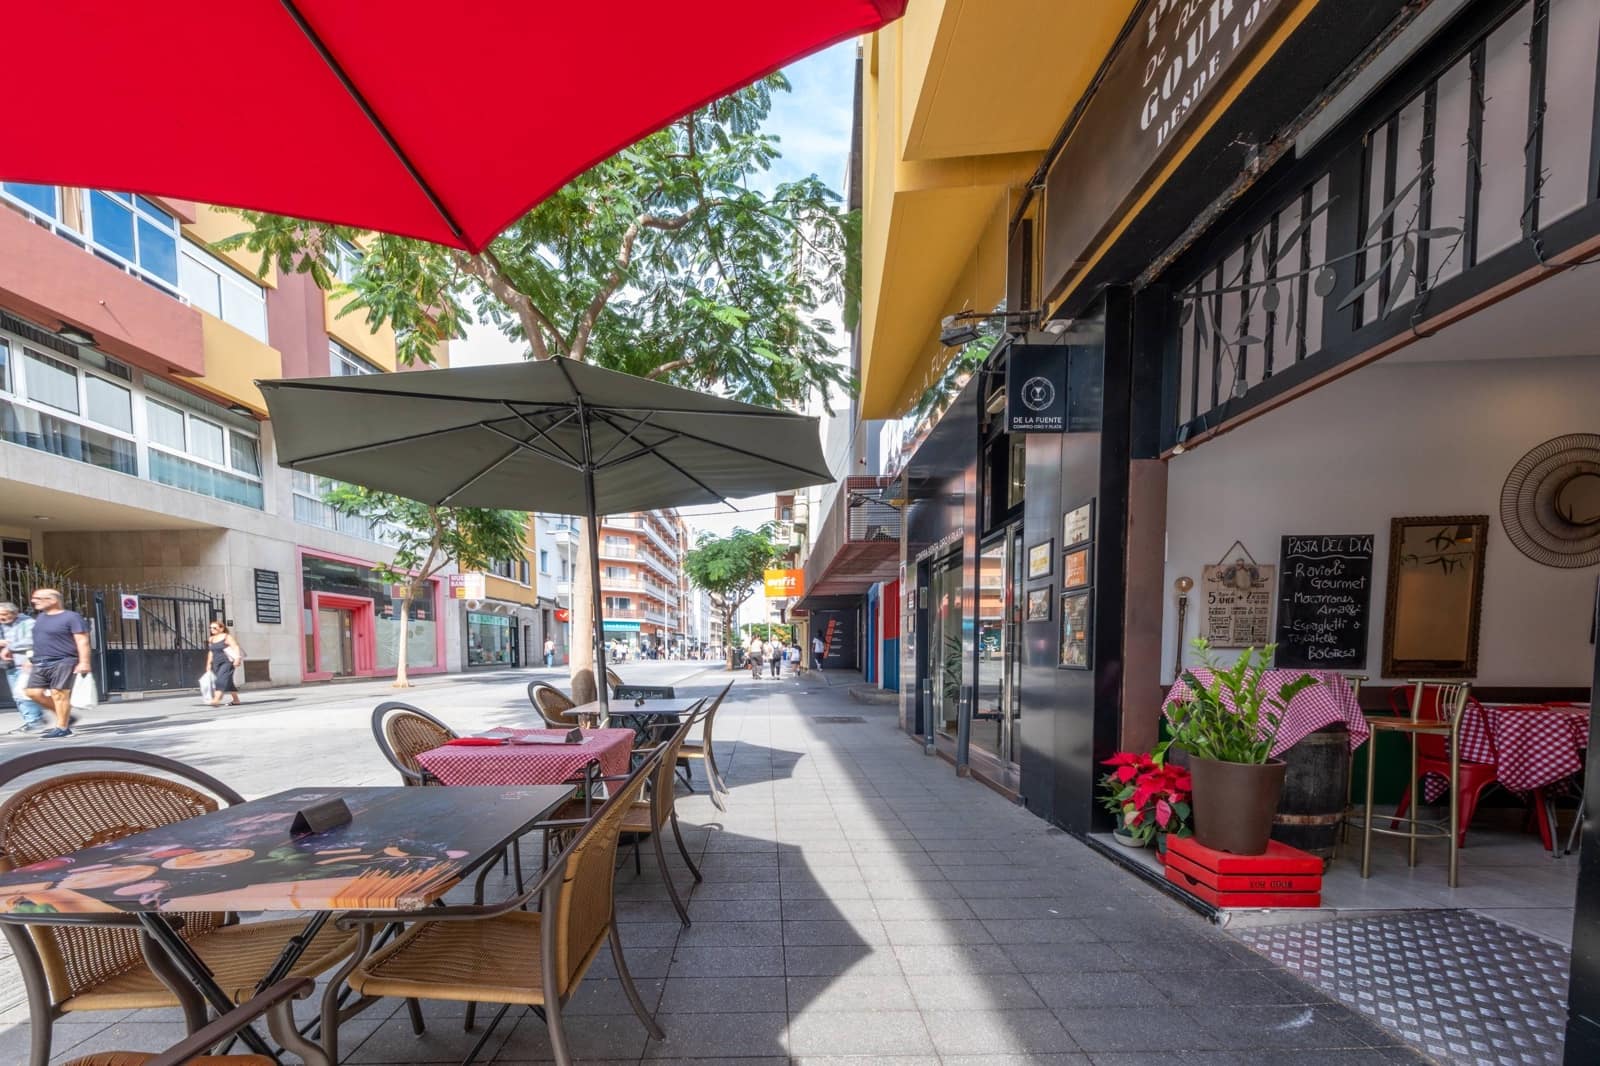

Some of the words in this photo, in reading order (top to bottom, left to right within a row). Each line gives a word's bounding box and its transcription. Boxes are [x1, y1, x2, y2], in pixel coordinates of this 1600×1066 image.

[1157, 50, 1220, 147] DESDE
[1013, 416, 1023, 424] DE
[1024, 416, 1034, 424] LA
[1035, 416, 1062, 424] FUENTE
[1287, 537, 1319, 554] PASTA
[1321, 537, 1343, 553] DEL
[1311, 576, 1367, 590] Gourmet
[1208, 591, 1216, 605] 5
